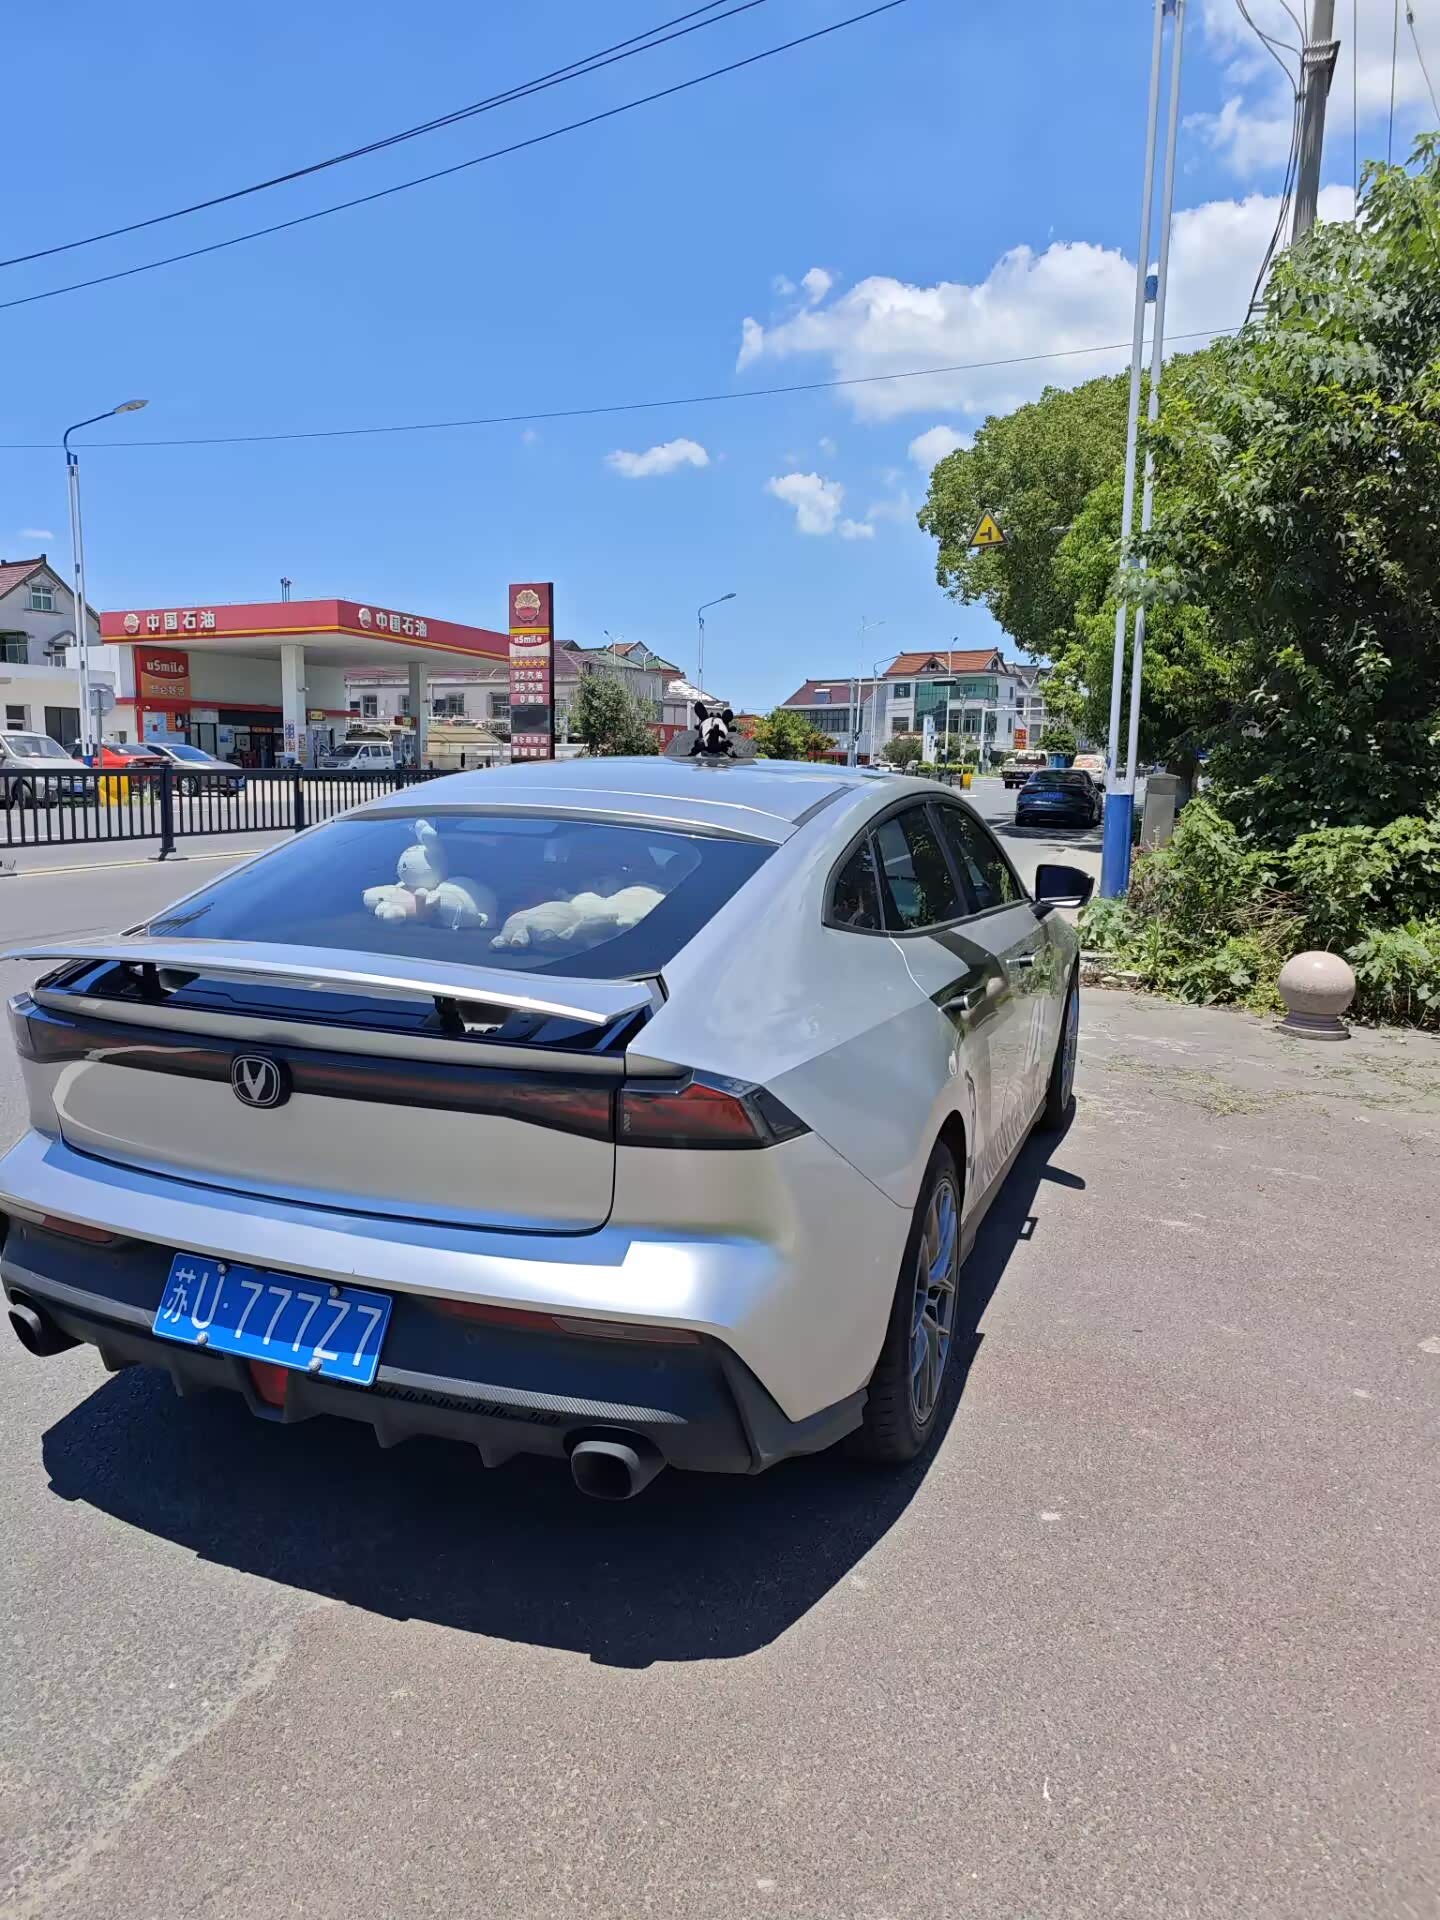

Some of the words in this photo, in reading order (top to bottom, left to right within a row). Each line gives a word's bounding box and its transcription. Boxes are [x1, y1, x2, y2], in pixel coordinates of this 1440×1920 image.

[146, 610, 216, 631] 中国石油
[375, 611, 428, 638] 中国石油
[146, 659, 185, 673] uSmile
[514, 682, 526, 692] 95
